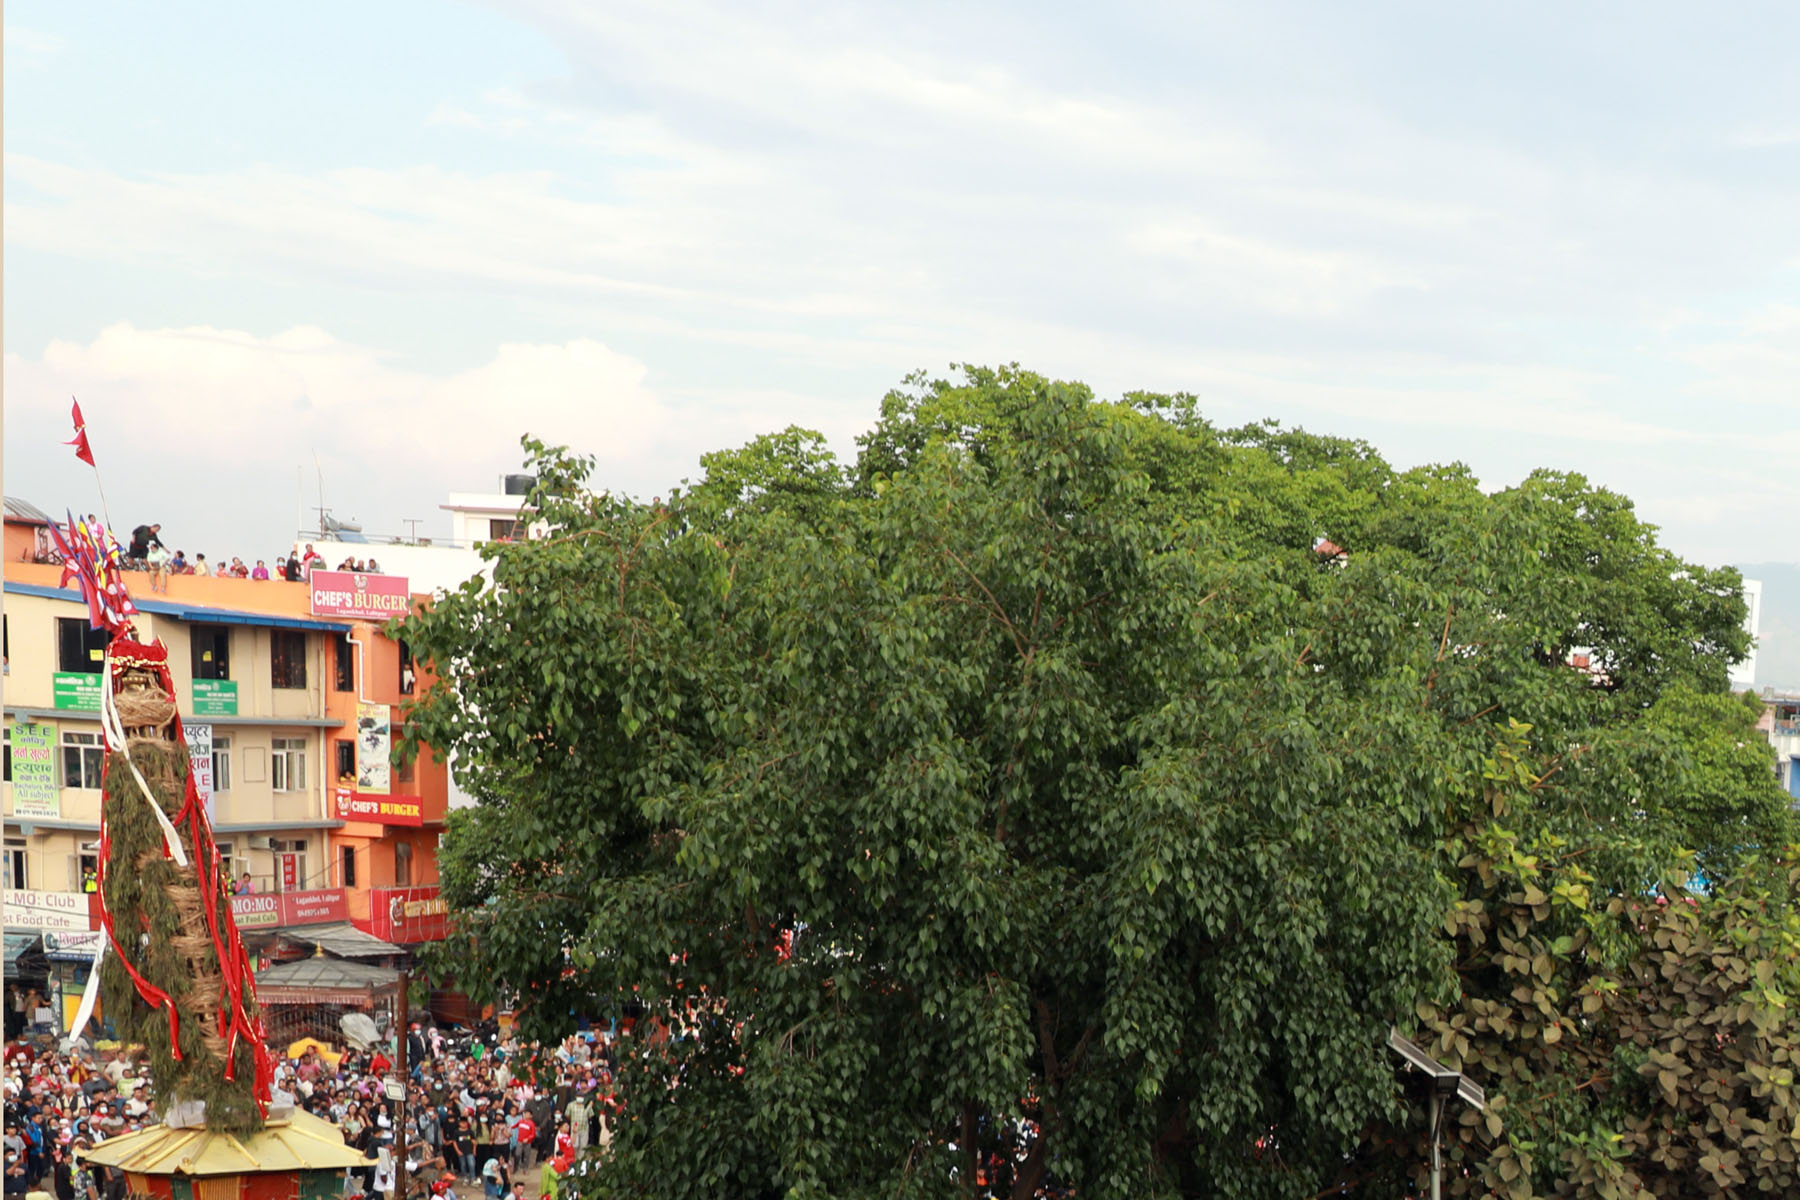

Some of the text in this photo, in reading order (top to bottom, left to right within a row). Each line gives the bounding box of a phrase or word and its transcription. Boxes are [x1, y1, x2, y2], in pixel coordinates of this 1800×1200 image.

[314, 590, 408, 611] CHEF'S BURGER
[351, 800, 420, 817] CHEF'S BURGER
[45, 894, 76, 908] Club
[16, 915, 43, 925] Food
[46, 916, 70, 927] Cafe
